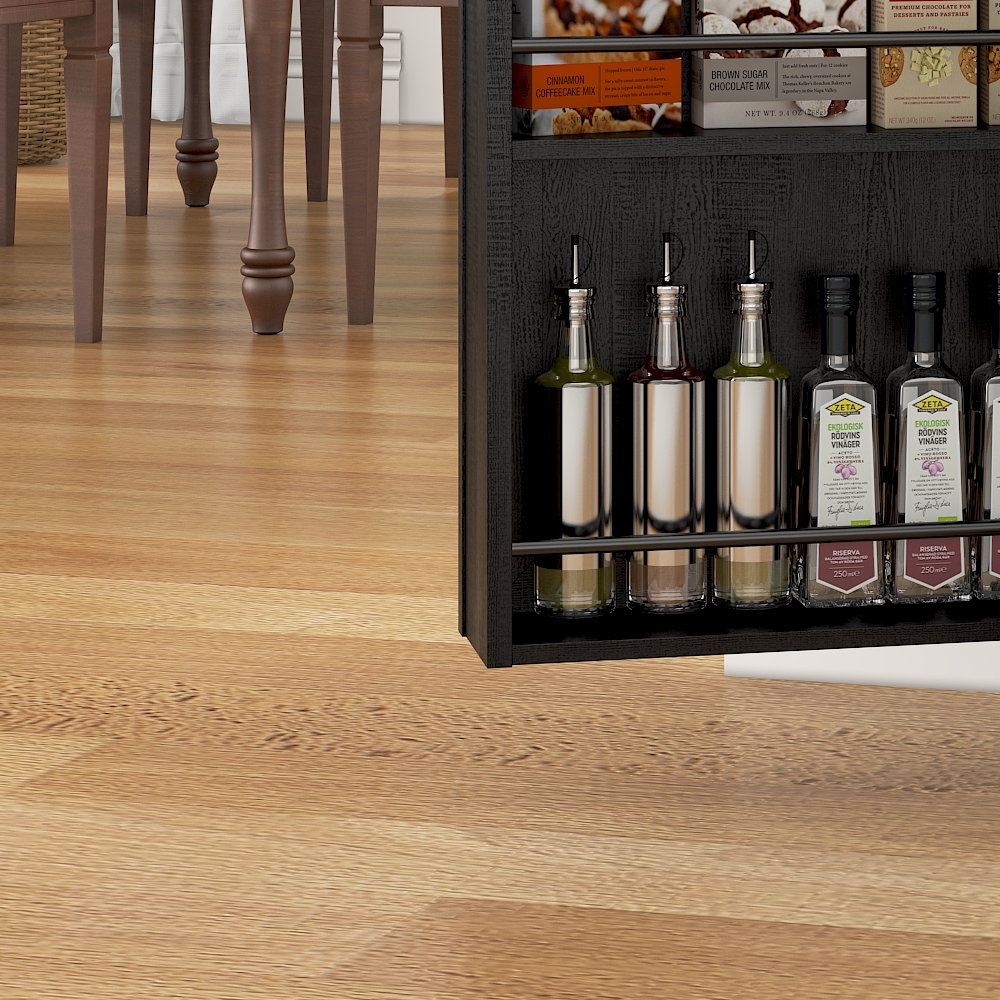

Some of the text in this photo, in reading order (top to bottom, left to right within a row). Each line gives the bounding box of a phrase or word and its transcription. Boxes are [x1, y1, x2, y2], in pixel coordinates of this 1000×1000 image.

[711, 69, 768, 79] BROWN SUGAR
[546, 75, 585, 86] CINNAMON
[709, 81, 770, 91] CHOCOLATE MIX
[535, 86, 596, 98] COFFEECAKE MIX
[828, 423, 864, 431] EKOLOGISK
[915, 419, 950, 428] EKOLOGISK
[831, 430, 861, 440] RÖDVINS
[918, 428, 947, 437] RÖDVINS
